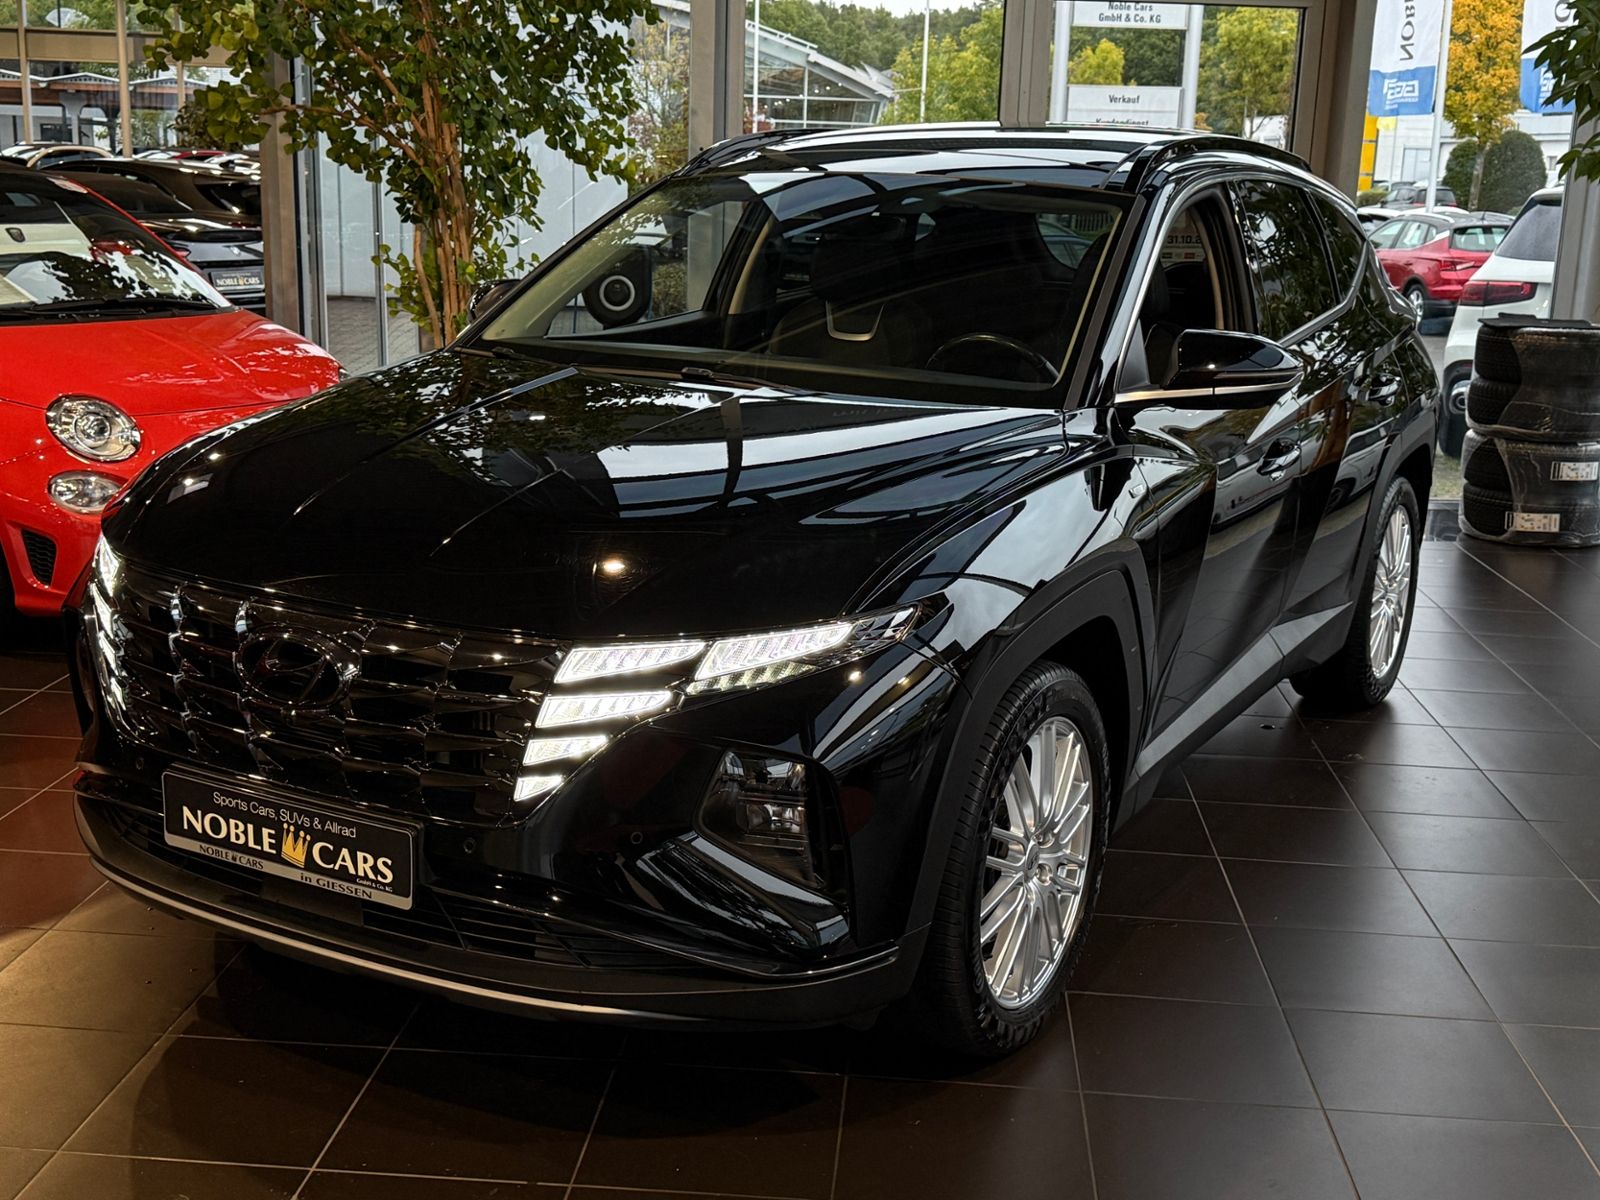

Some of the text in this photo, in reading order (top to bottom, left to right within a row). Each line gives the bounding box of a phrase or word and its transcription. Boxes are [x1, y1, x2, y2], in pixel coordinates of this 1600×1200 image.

[1108, 3, 1153, 12] Noble Cars
[1098, 13, 1161, 23] GmbH & Co. KG
[1108, 95, 1140, 104] Verkauf
[1096, 118, 1149, 126] Kddienst
[216, 276, 260, 286] NOBLE CARS
[213, 791, 356, 838] Sports Cars, SUVs & Allrad
[182, 805, 394, 884] NOBLE CARS
[199, 844, 264, 870] NOBLE CARS
[300, 872, 373, 900] in GIESSEN
